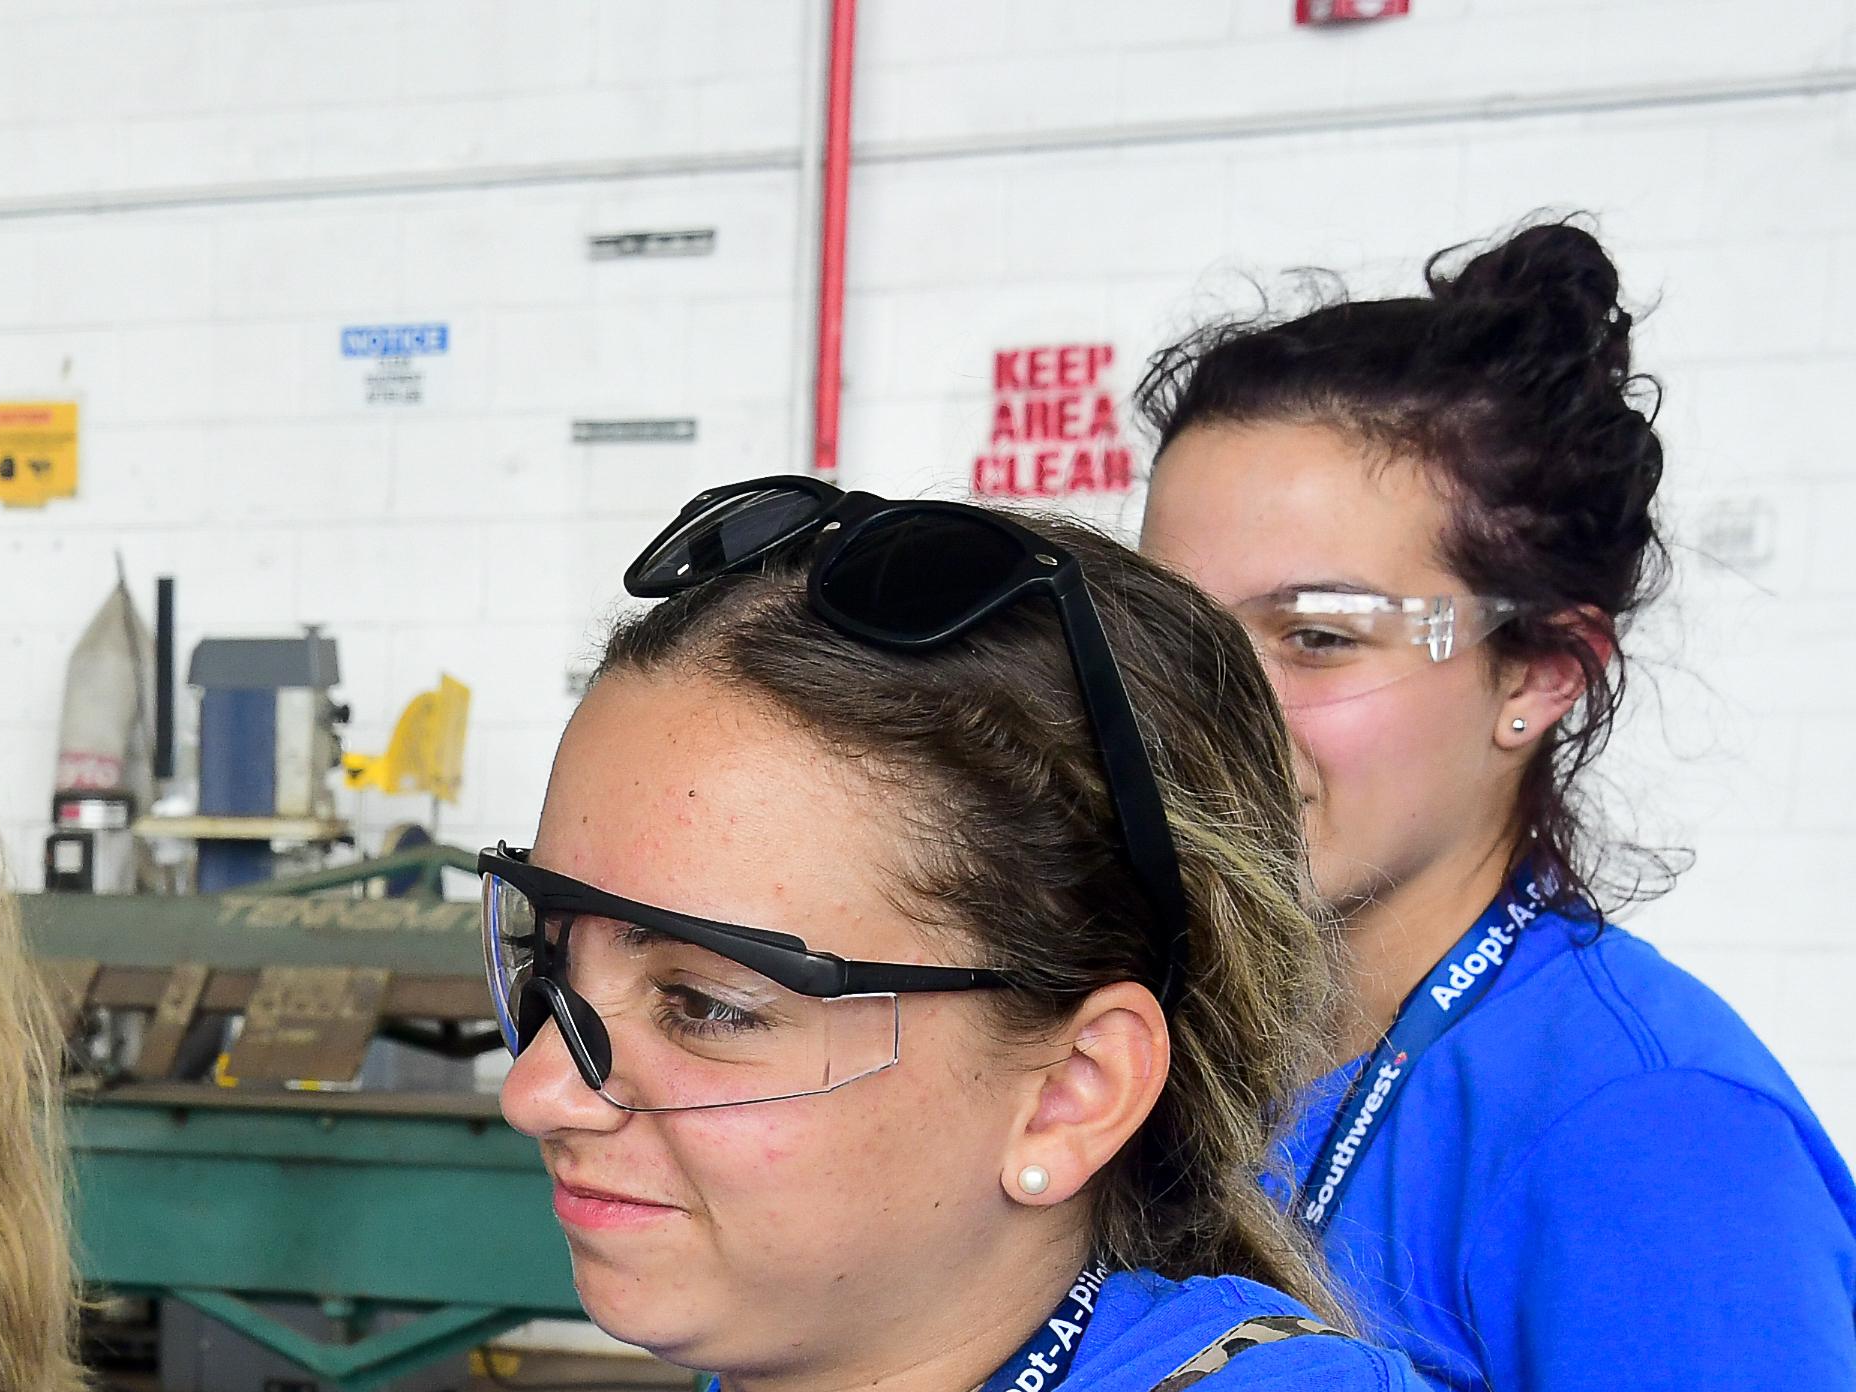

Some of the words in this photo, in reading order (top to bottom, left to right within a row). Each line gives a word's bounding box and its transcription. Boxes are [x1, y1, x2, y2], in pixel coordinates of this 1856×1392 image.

[995, 344, 1113, 390] KEEP
[992, 394, 1118, 444] AREA
[973, 447, 1132, 498] CLEAN
[1306, 1063, 1401, 1223] Southwest
